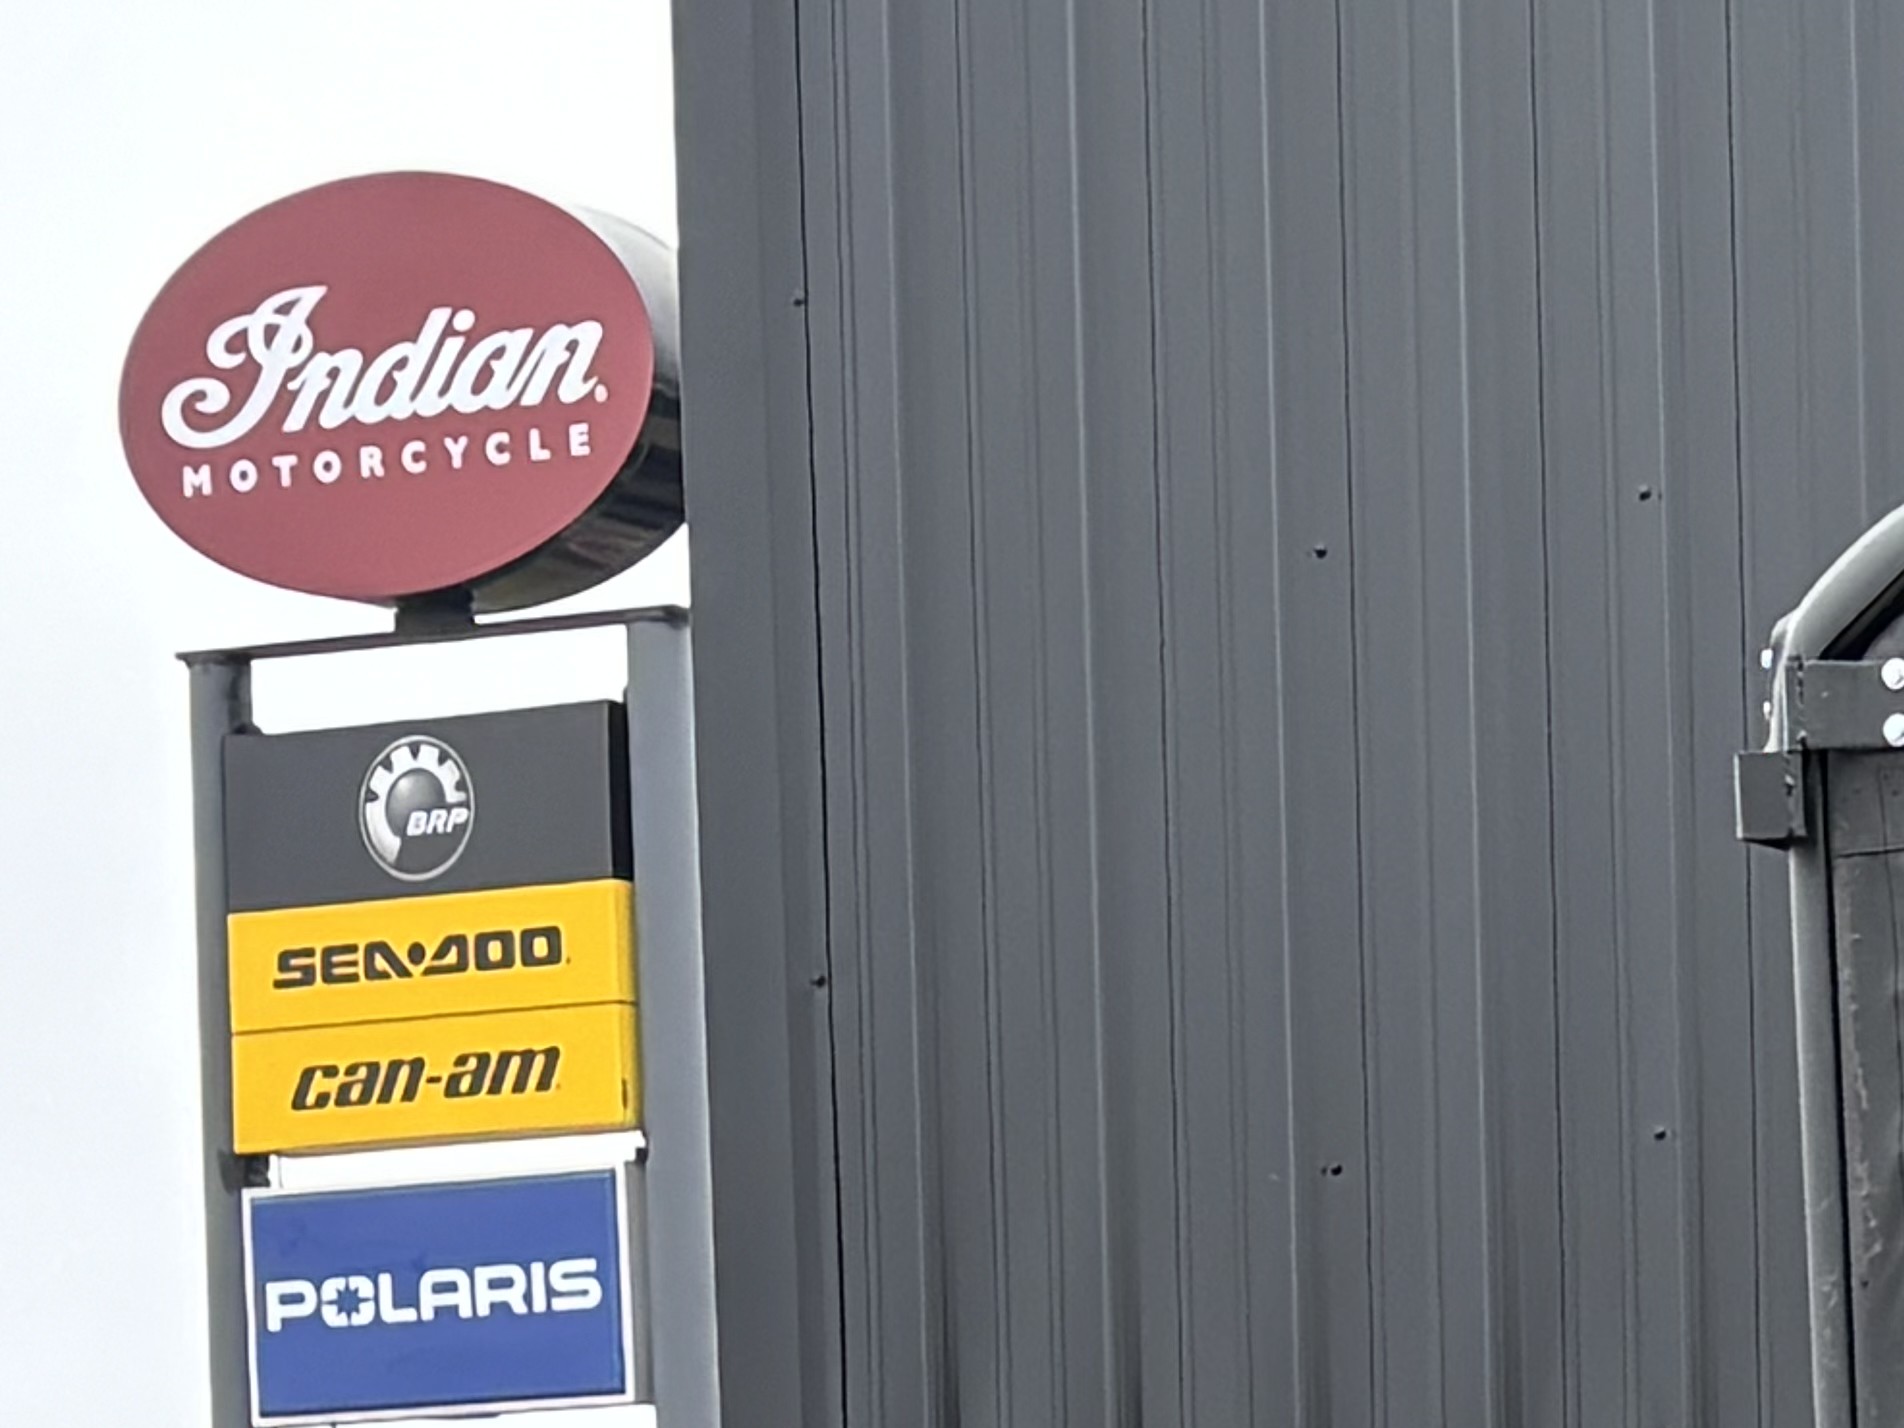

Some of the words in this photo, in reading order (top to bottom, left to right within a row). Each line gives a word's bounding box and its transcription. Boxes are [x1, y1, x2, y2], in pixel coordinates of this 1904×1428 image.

[161, 285, 603, 448] Indian
[182, 423, 592, 498] MOTORCYCLE
[406, 807, 469, 837] BRP
[291, 1045, 561, 1111] can-am
[265, 1257, 603, 1333] POLARIS
